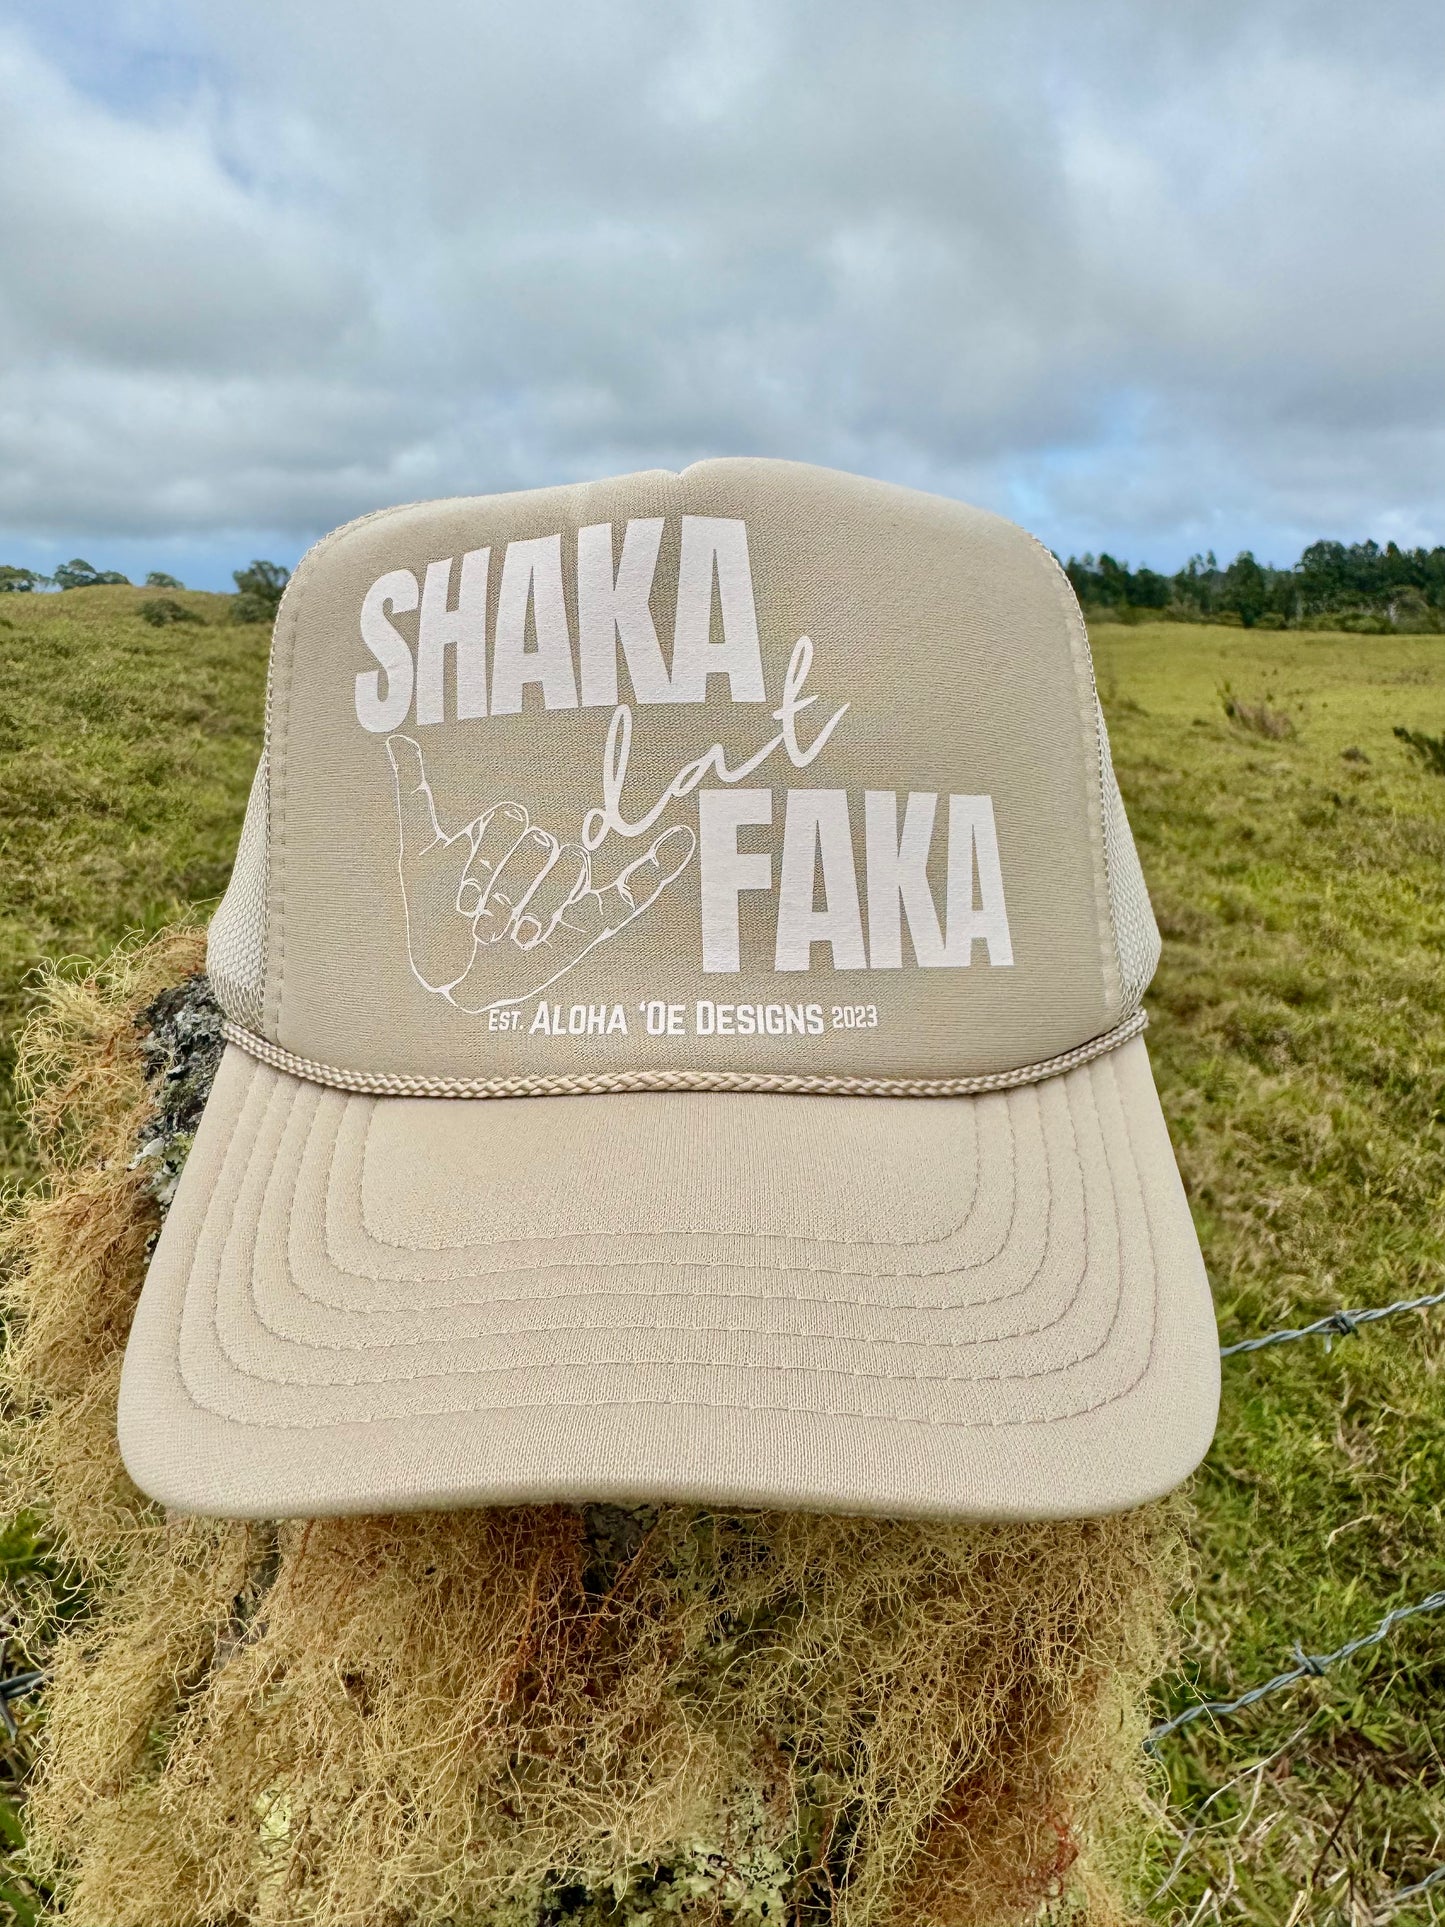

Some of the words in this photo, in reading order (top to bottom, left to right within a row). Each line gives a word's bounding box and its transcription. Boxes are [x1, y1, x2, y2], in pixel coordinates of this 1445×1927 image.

[354, 515, 767, 733] SHAKA
[582, 635, 850, 850] dat
[699, 788, 1015, 974] FAKA
[528, 1001, 628, 1035] ALOHA
[696, 1001, 825, 1035] DESIGNS
[832, 1005, 879, 1029] 2023
